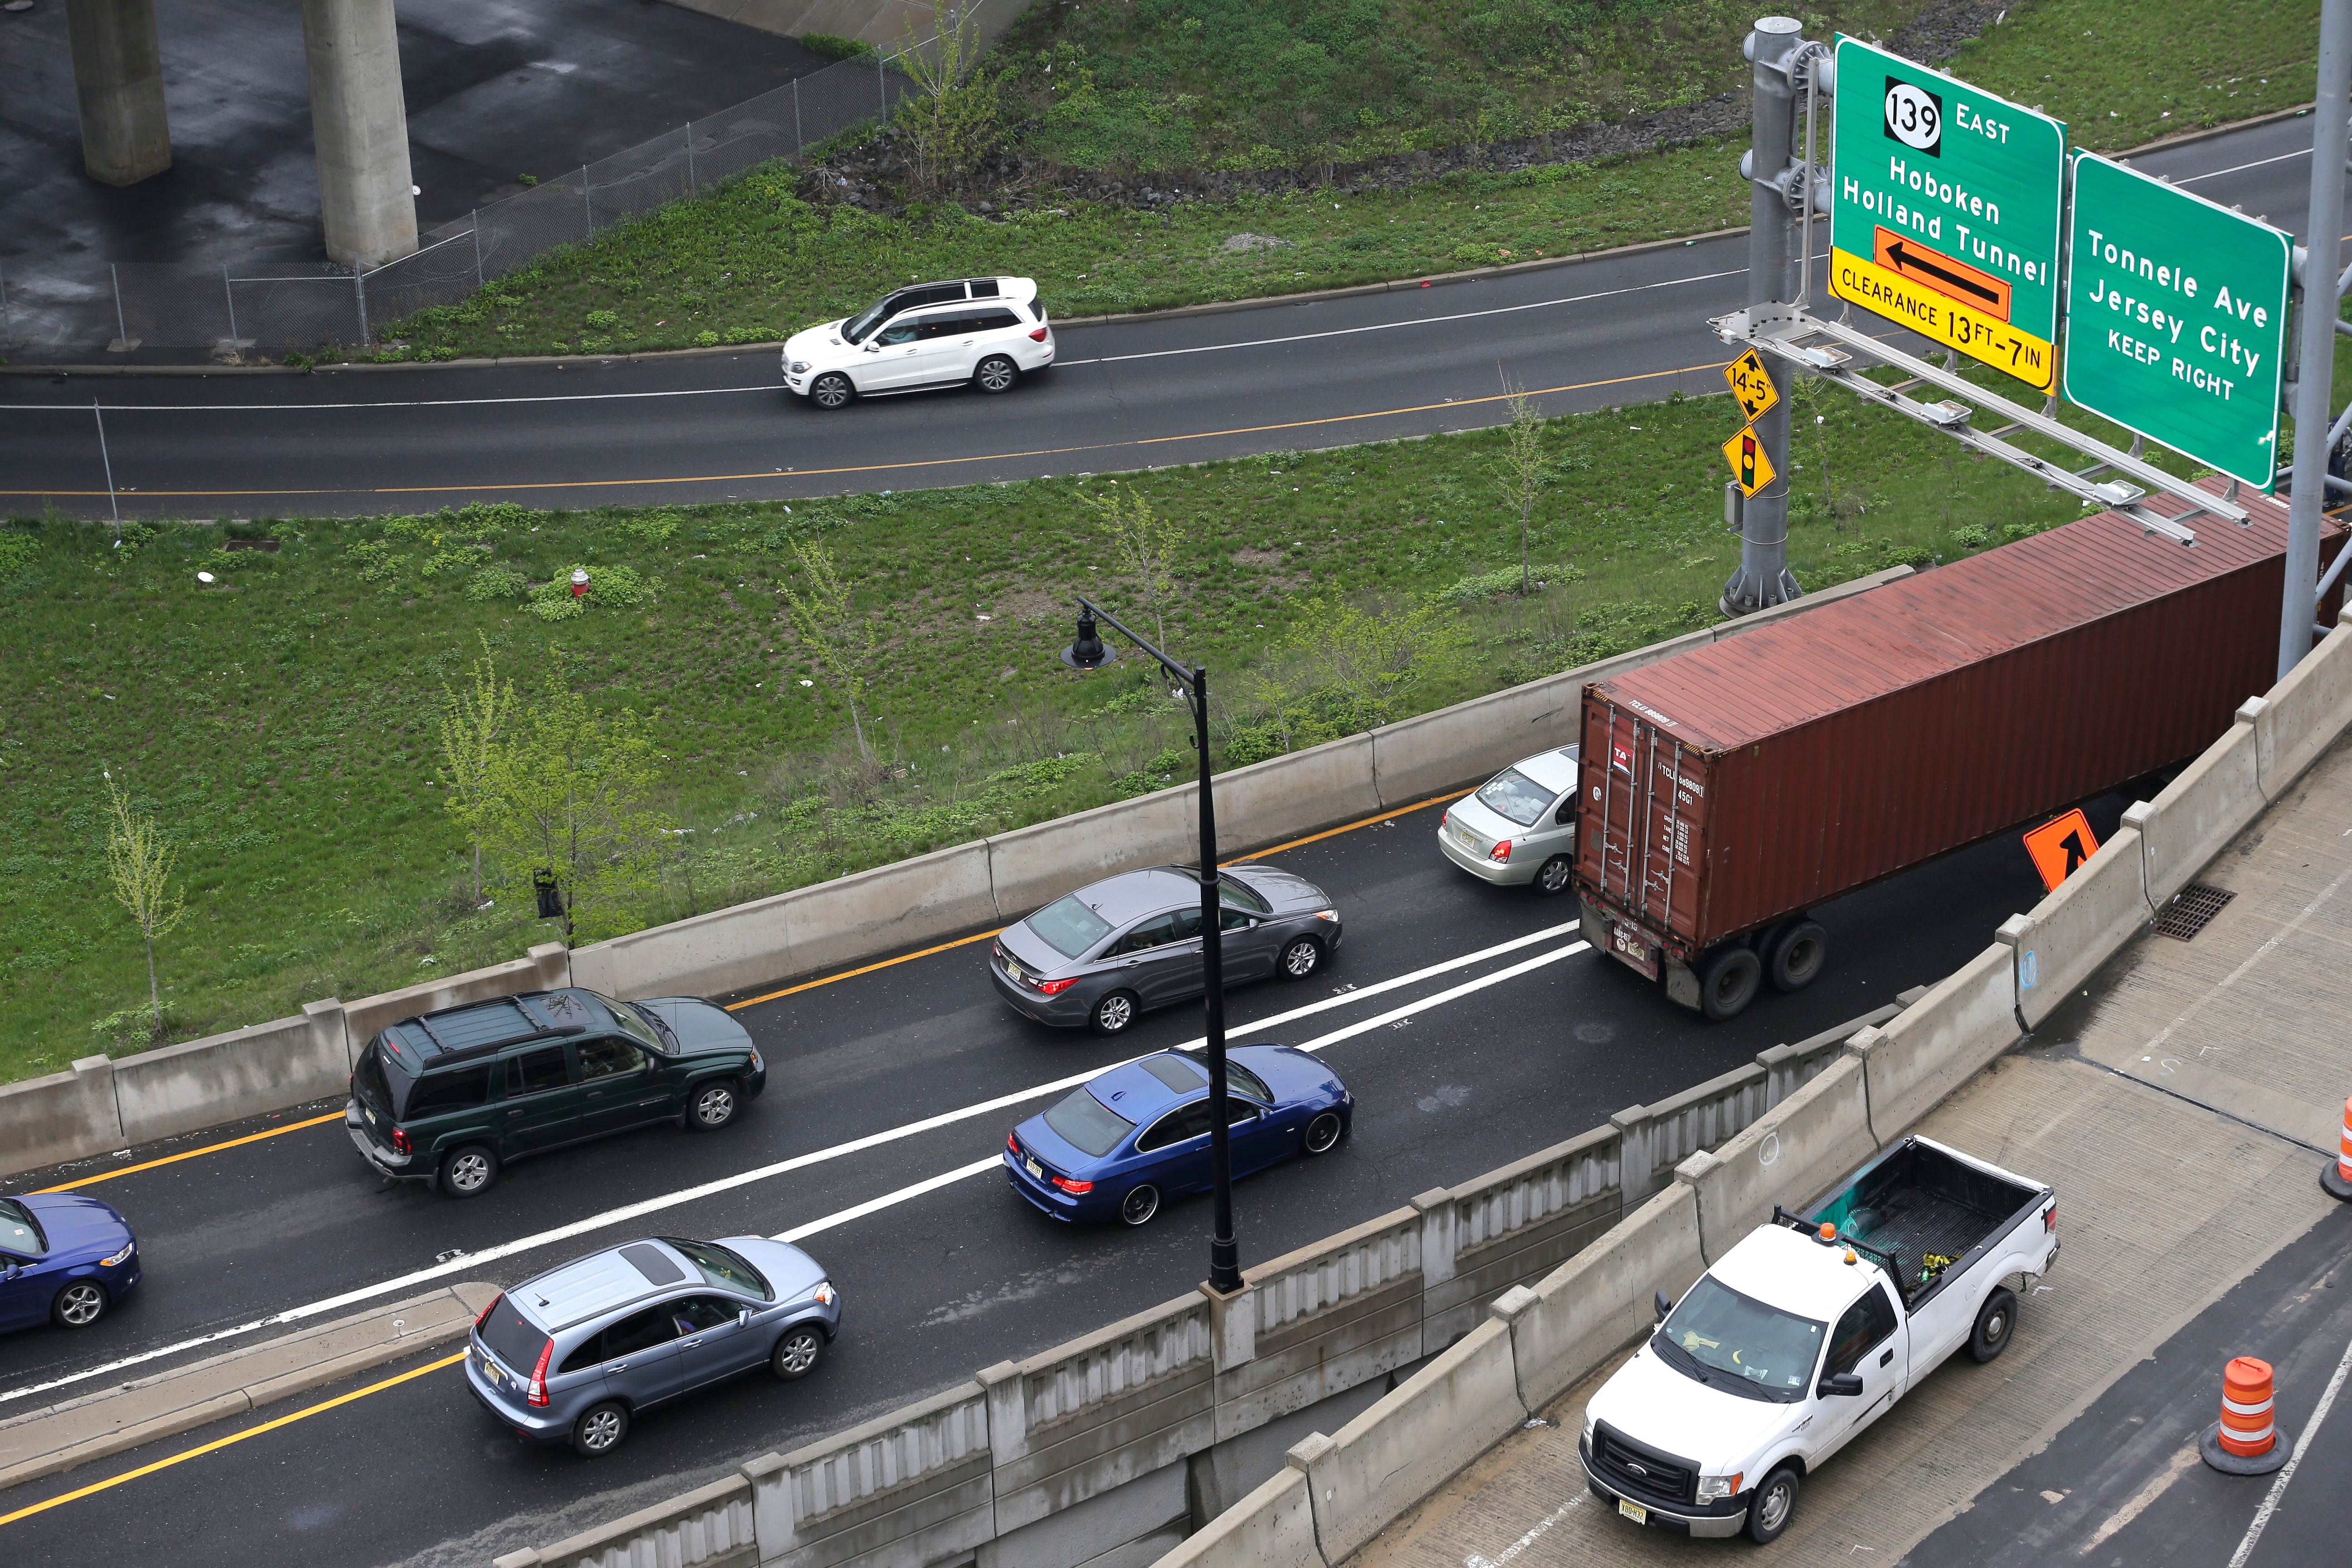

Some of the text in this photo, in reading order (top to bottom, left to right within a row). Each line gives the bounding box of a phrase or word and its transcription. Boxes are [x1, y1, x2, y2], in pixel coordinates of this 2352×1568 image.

[1891, 93, 2010, 144] 139 EAST
[1890, 156, 2000, 225] Hoboken
[1843, 176, 2046, 286] Holland Tunnel
[1842, 268, 1937, 326] CLEARANCE
[2088, 229, 2268, 328] Tonnele Ave
[2089, 279, 2260, 377] Jersey City
[1732, 368, 1770, 401] 14'-5"
[2108, 328, 2234, 401] KEEP RIGHT
[1678, 789, 1693, 806] 45G1
